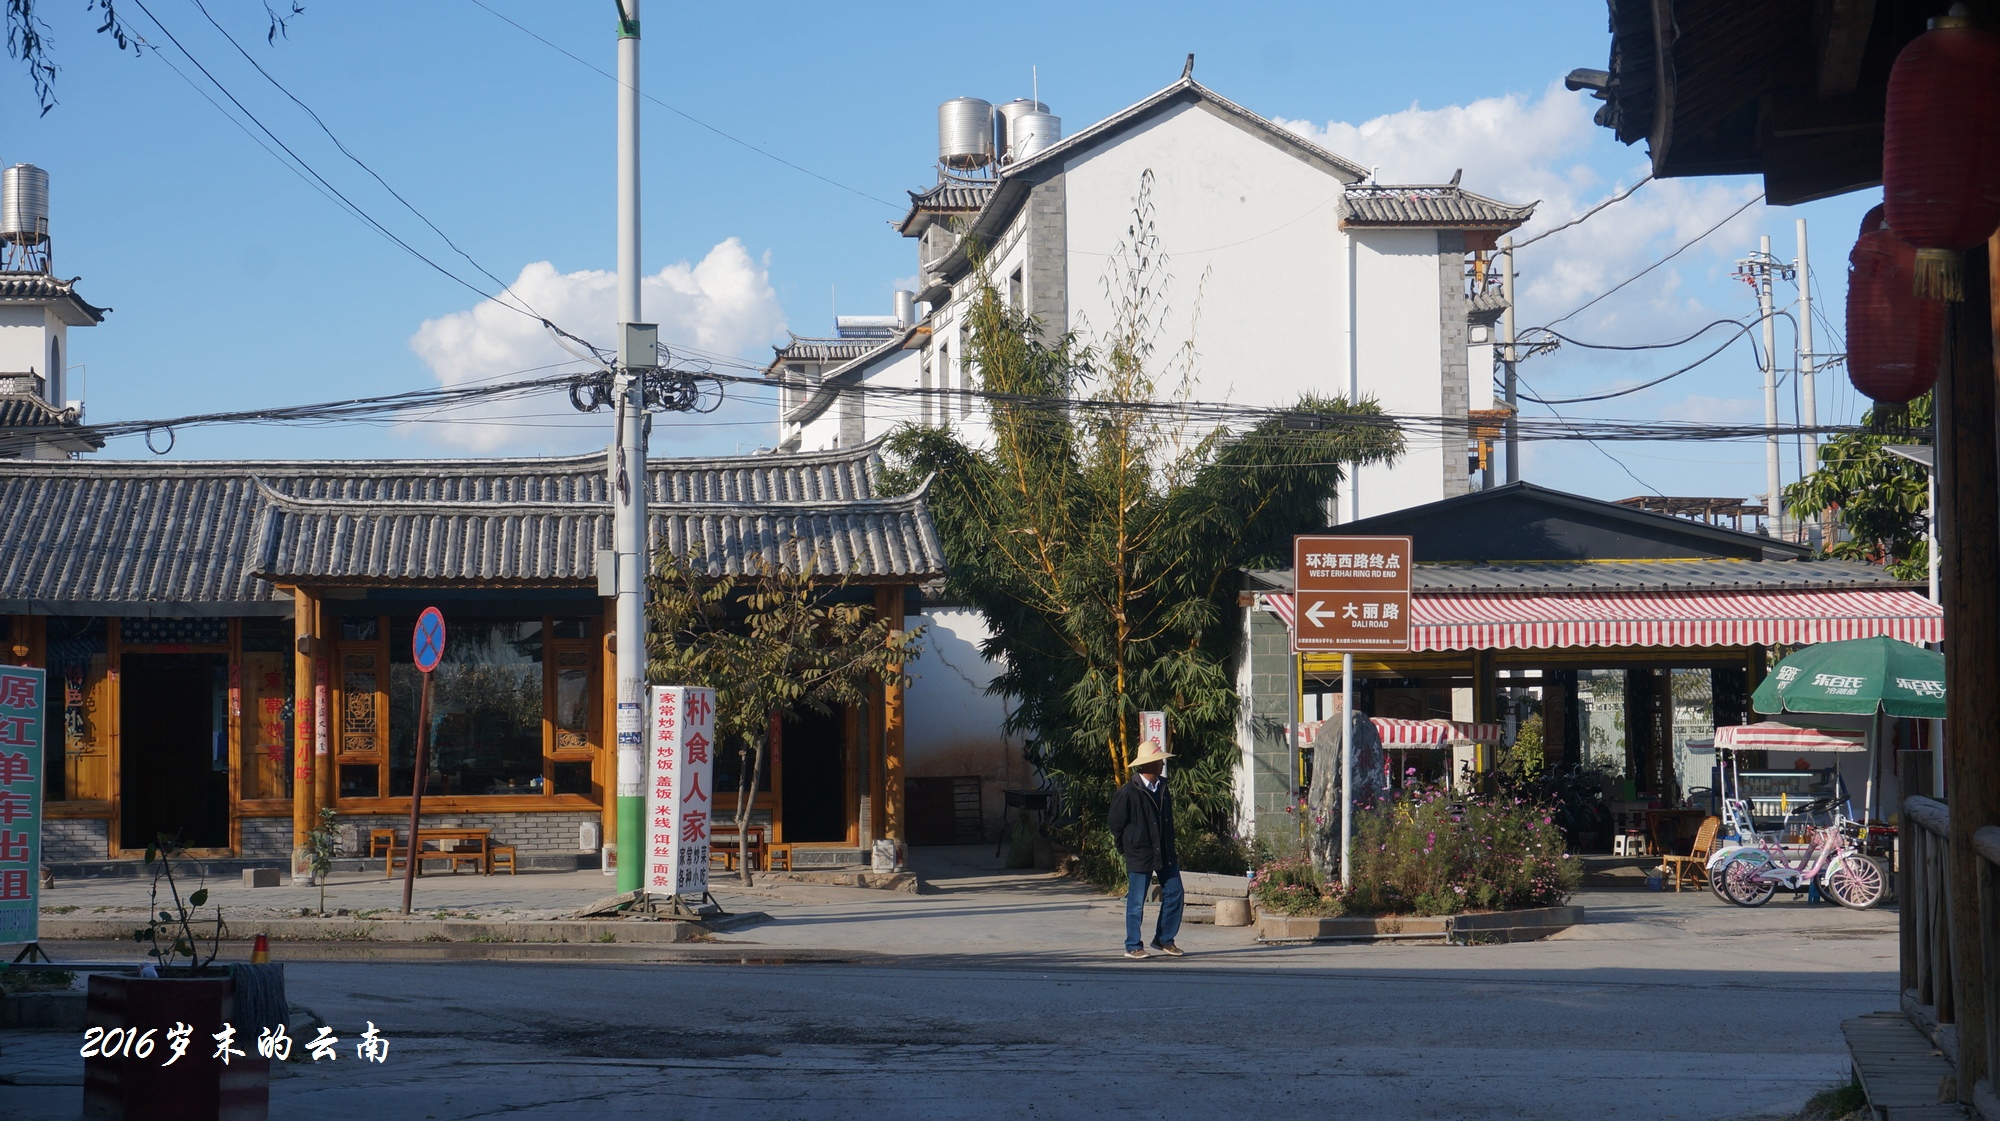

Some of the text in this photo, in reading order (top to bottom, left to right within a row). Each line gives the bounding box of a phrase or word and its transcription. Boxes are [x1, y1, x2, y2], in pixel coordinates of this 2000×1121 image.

[1305, 553, 1401, 569] 环海西路终点
[1309, 570, 1397, 578] WEST ERHAI RING RD END
[1342, 602, 1399, 620] 大丽路
[1351, 620, 1389, 628] DALI ROAD
[1811, 673, 1865, 688] 乐百氏
[296, 698, 314, 785] 特色小吃
[682, 692, 711, 843] 朴食人家
[0, 674, 39, 901] 原红单车出租
[652, 692, 676, 886] 家常炒菜 炒饭 盖饭 米线 饵丝 面条
[678, 845, 707, 866] 家常炒菜
[678, 867, 707, 888] 各种小吃
